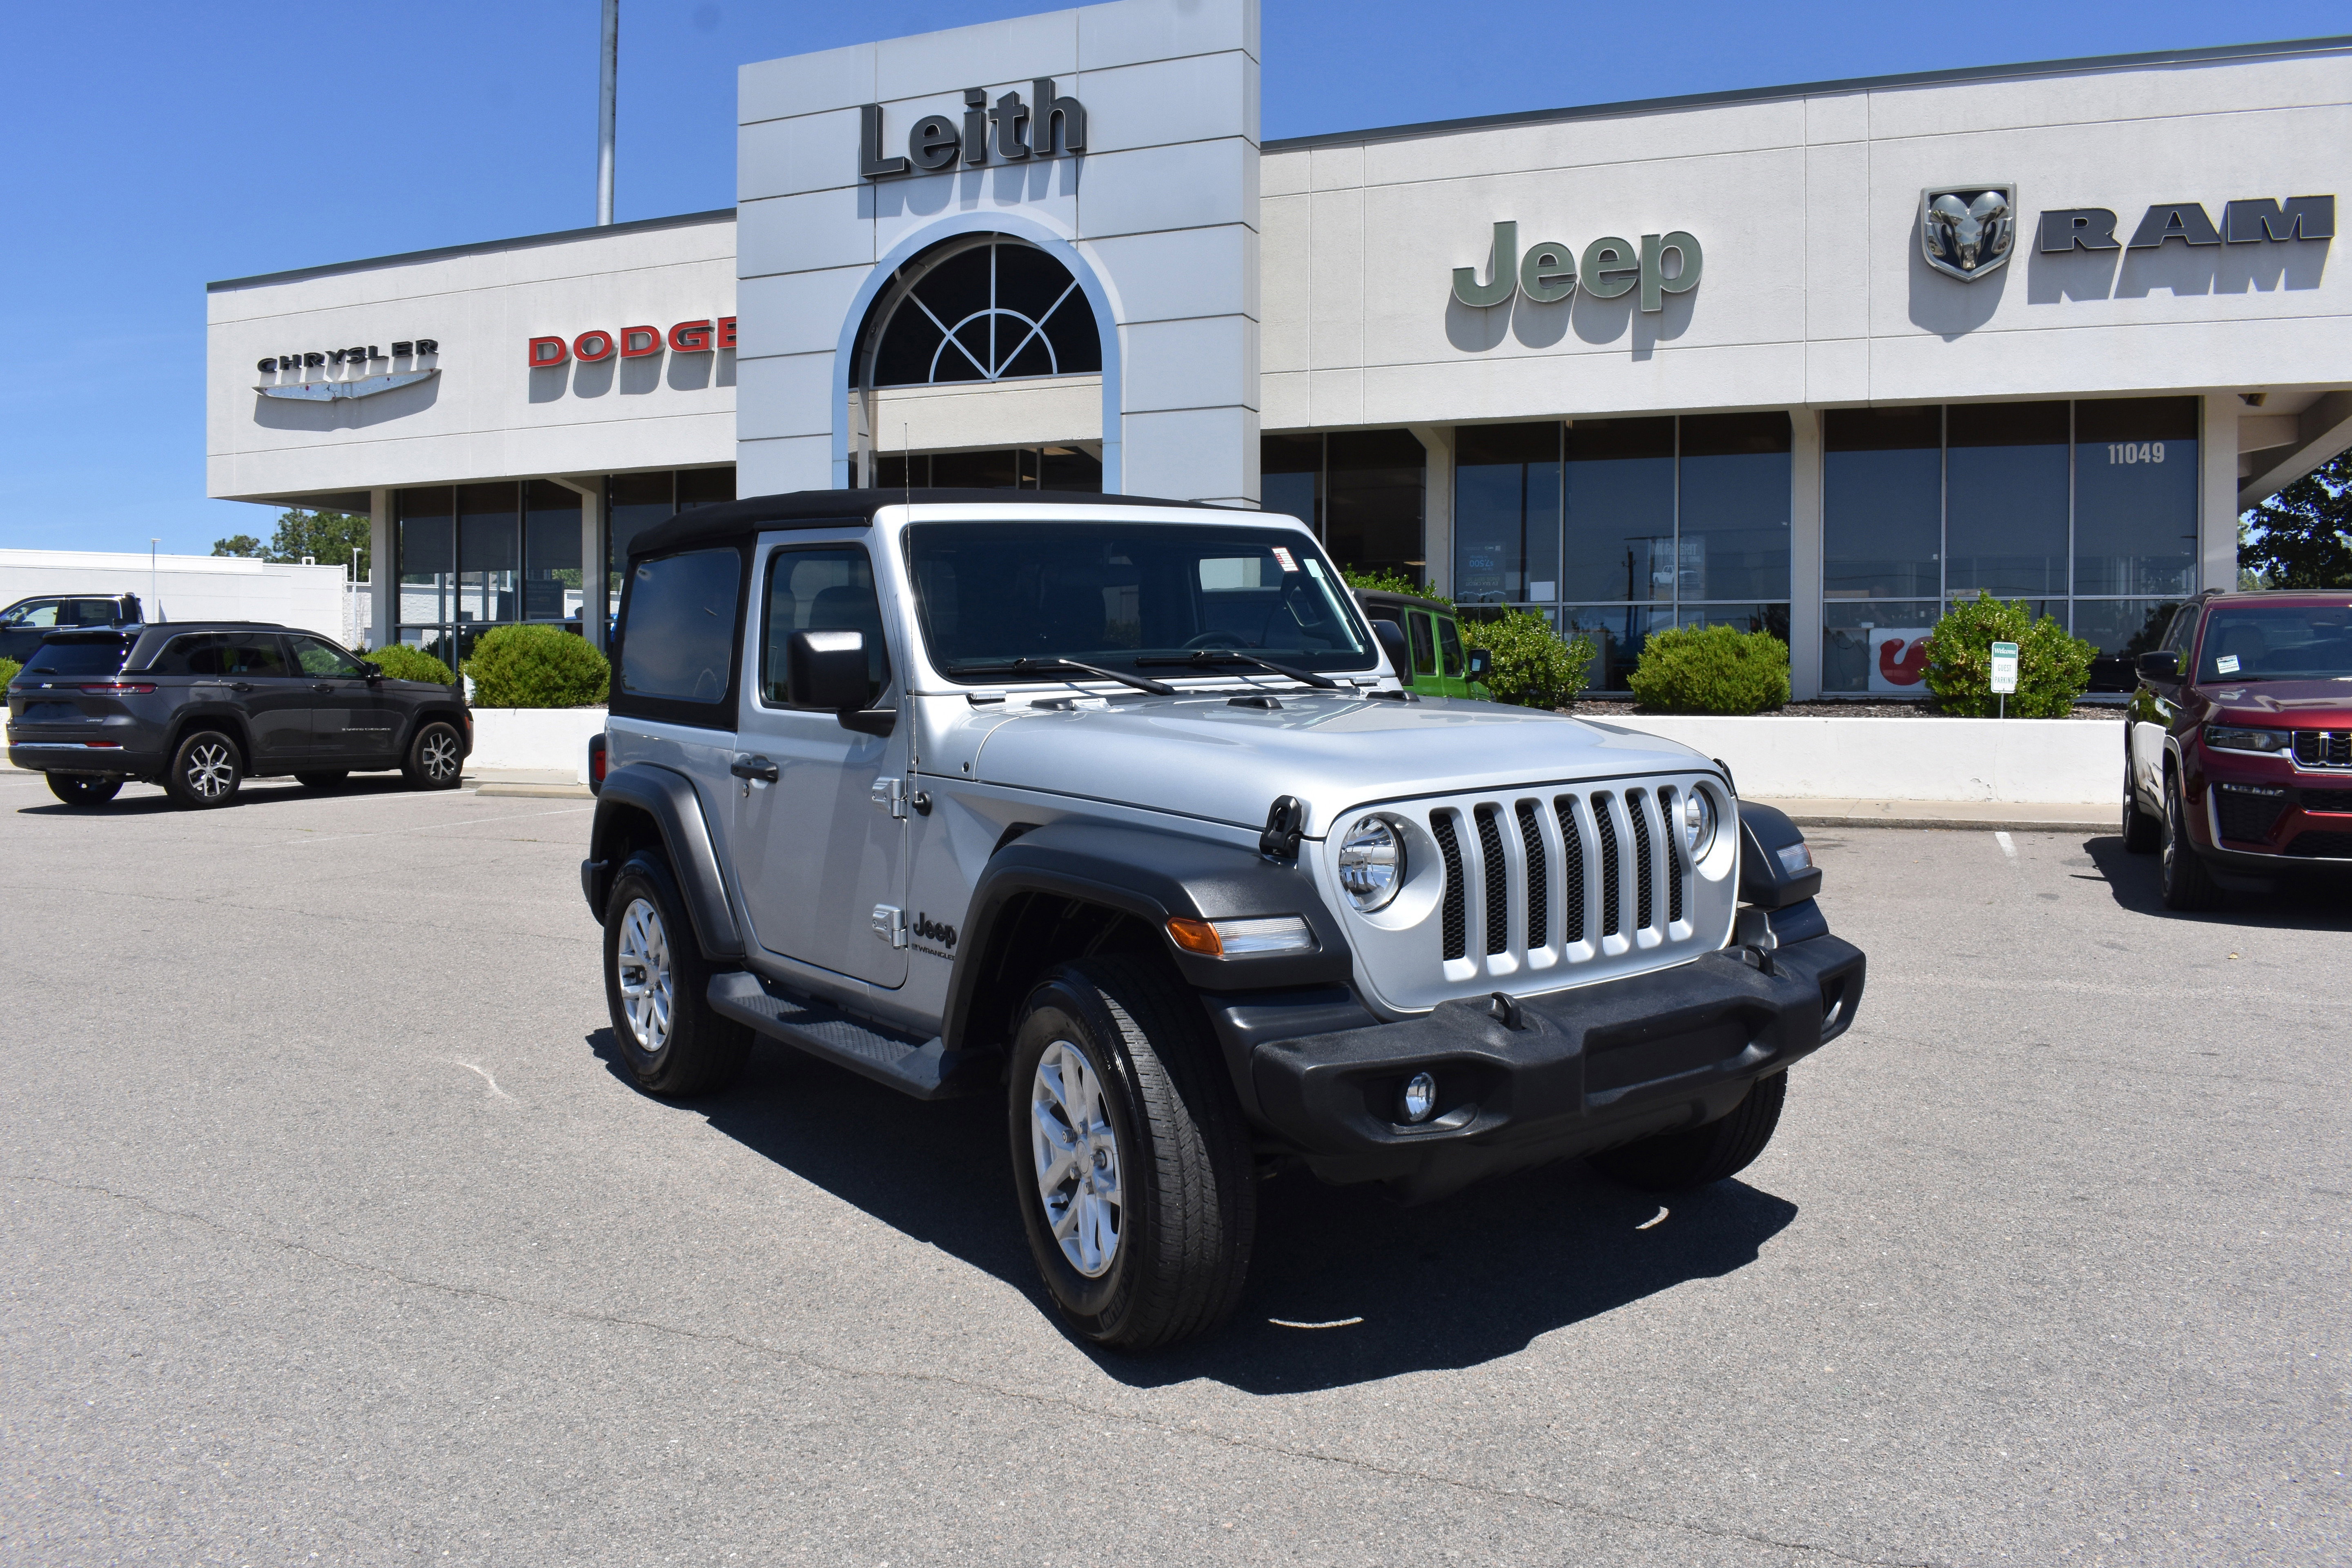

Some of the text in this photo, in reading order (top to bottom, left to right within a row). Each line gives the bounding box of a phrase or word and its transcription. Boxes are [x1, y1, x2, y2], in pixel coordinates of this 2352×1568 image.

[860, 78, 1087, 178] Leith
[2041, 195, 2336, 254] RAM
[1452, 220, 1703, 313] Jeep
[257, 339, 439, 373] CHRYSLER
[2108, 442, 2165, 464] 11049
[913, 911, 957, 949] Jeep
